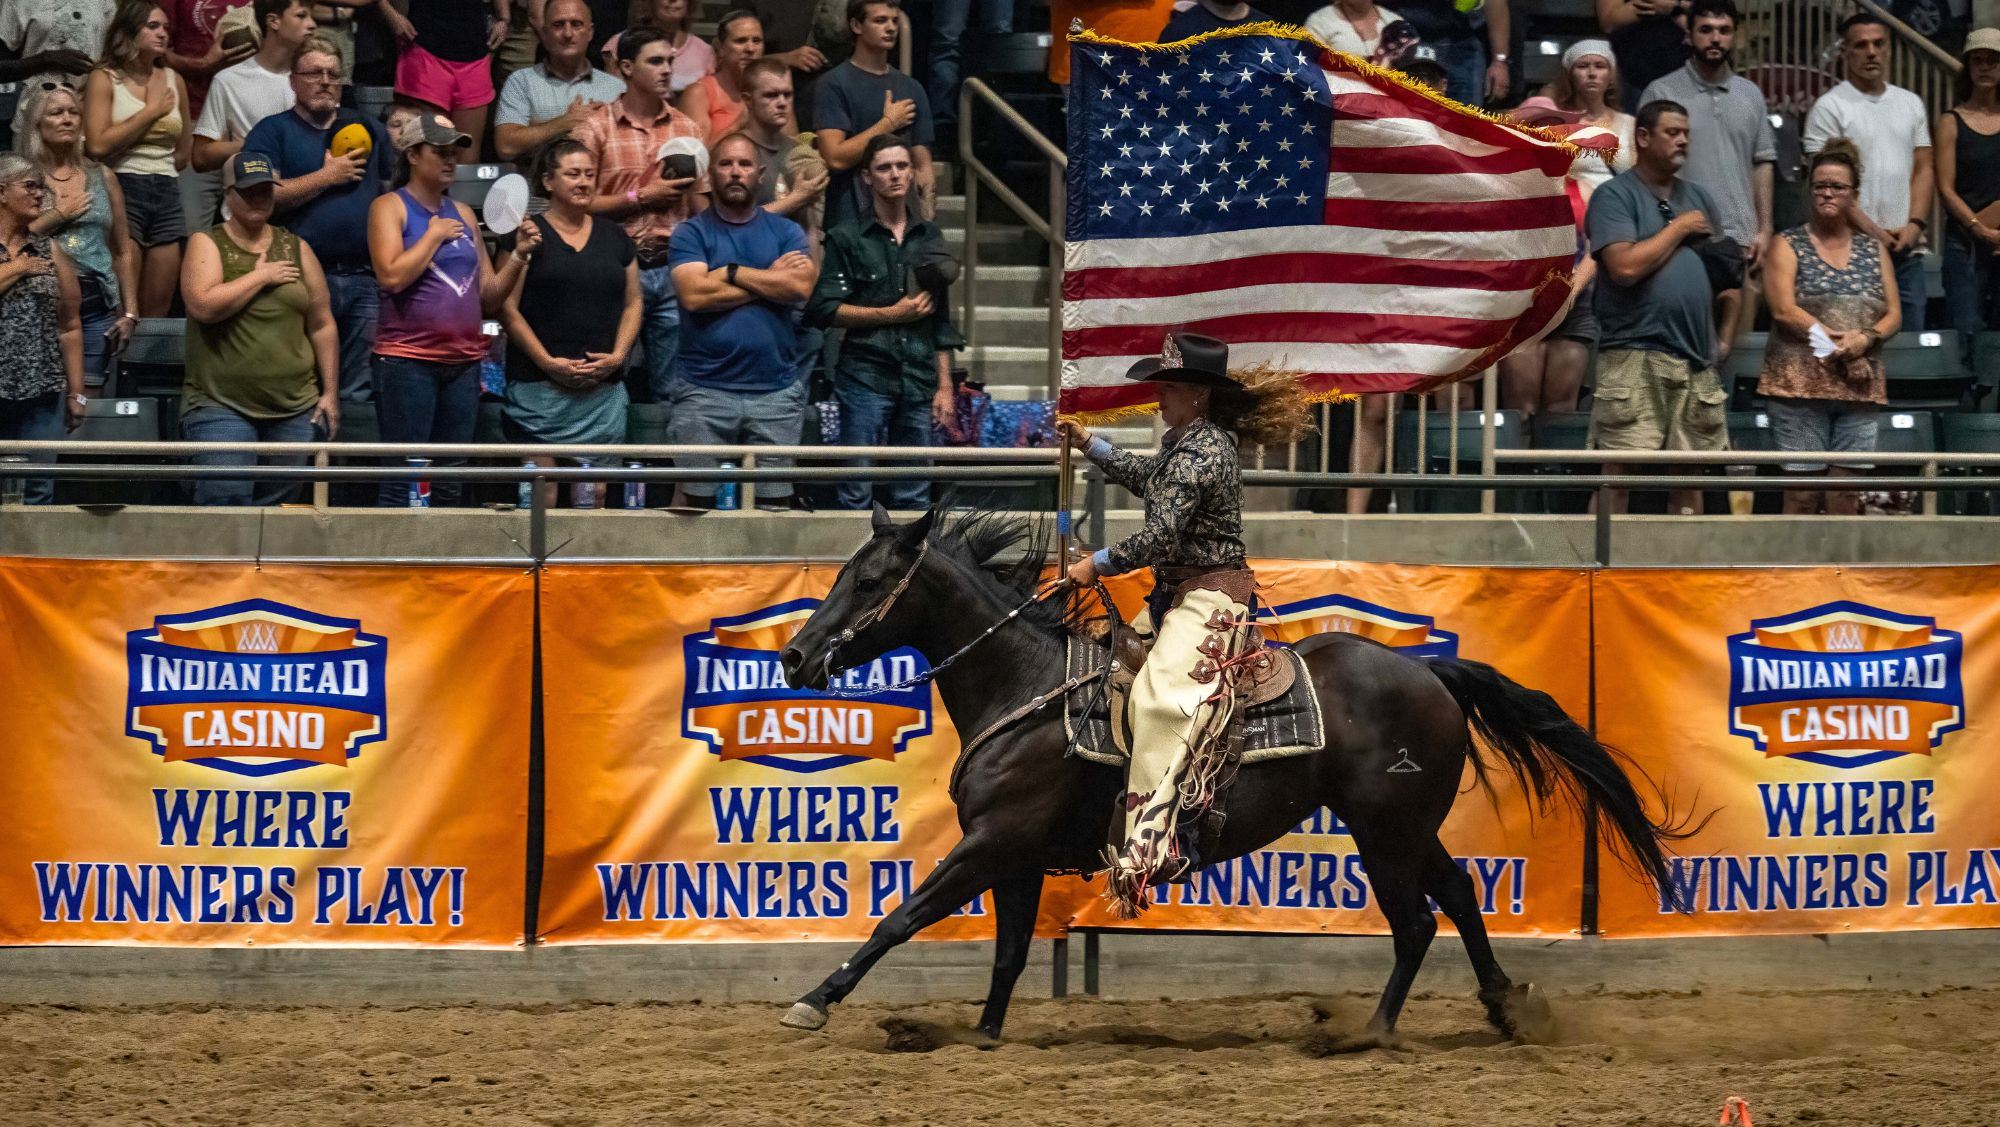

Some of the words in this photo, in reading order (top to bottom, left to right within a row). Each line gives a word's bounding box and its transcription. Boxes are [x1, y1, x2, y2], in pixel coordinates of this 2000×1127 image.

[140, 654, 261, 692] INDIAN
[271, 658, 369, 697] HEAD
[695, 655, 789, 694] INDIA
[832, 655, 916, 693] EAD
[1741, 655, 1851, 693] INDIAN
[1860, 653, 1946, 690] HEAD
[183, 709, 325, 750] CASINO
[737, 707, 874, 746] CASINO
[1780, 705, 1910, 743] CASINO
[152, 788, 351, 848] WHERE
[708, 786, 900, 843] WHERE
[1757, 779, 1935, 838] WHERE
[32, 862, 296, 924] WINNERS
[315, 866, 467, 926] PLAY!
[595, 860, 851, 921] WINNERS
[1659, 852, 1888, 915] WINNERS
[1905, 848, 2000, 908] PLA
